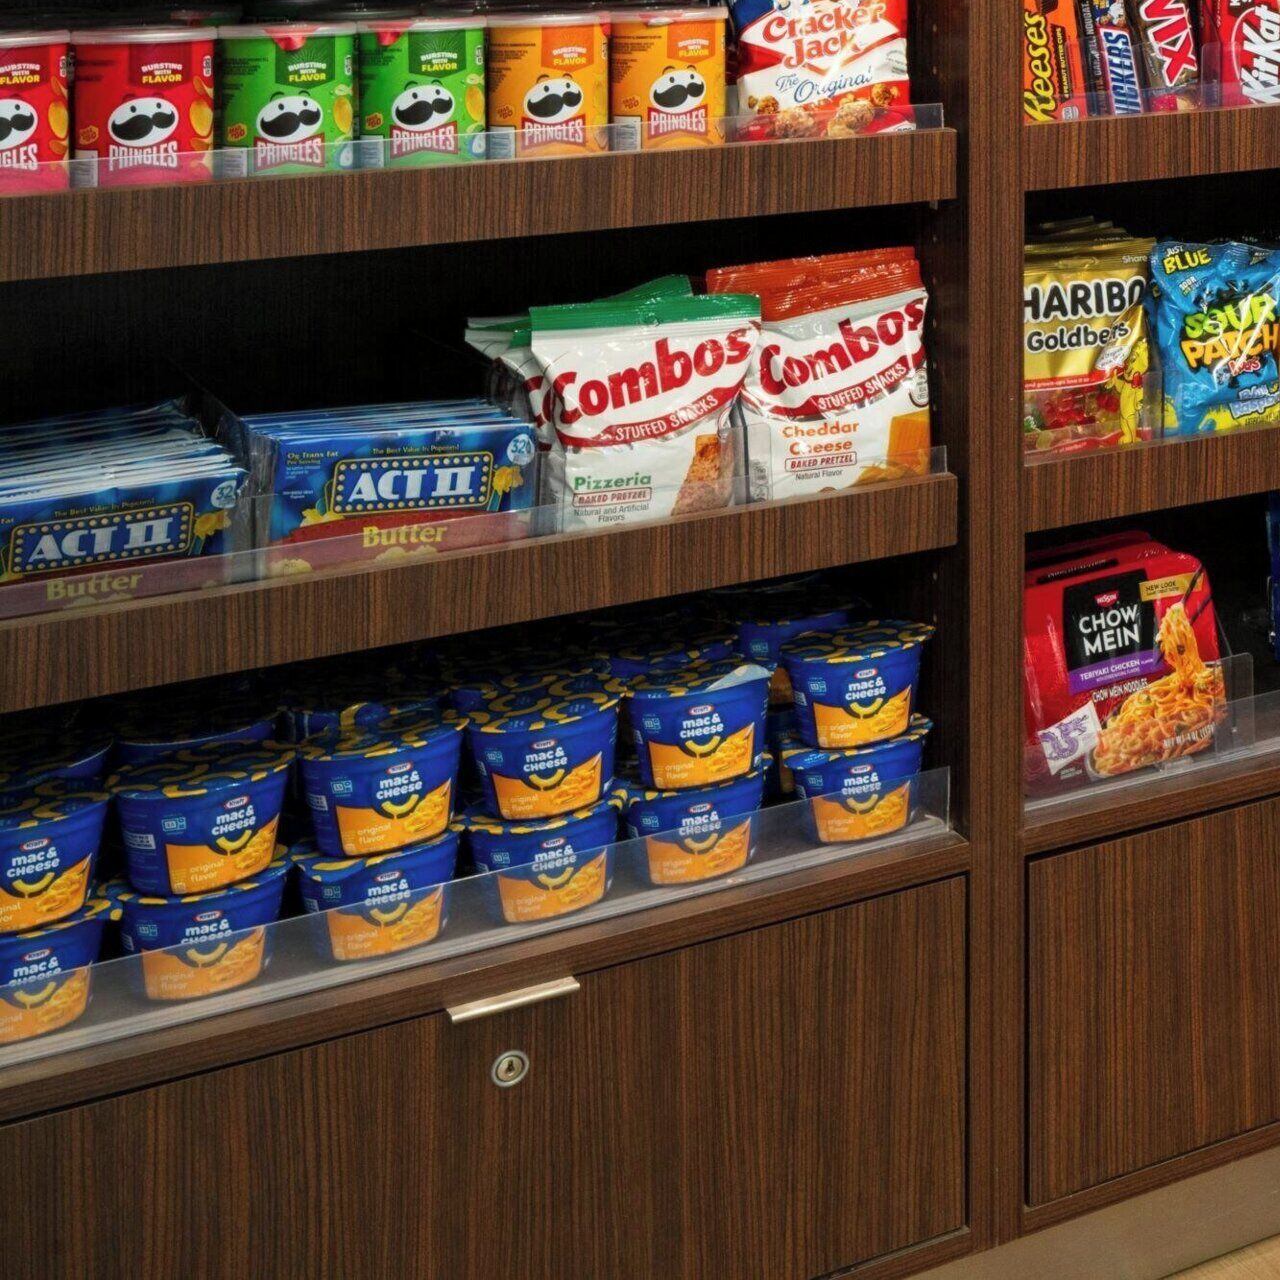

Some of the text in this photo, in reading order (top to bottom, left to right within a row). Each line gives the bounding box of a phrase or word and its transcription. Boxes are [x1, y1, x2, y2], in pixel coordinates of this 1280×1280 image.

[761, 1, 886, 45] Cracker
[782, 32, 862, 71] Jack
[142, 73, 182, 84] FLAVOR
[288, 71, 328, 82] FLAVOR
[775, 74, 800, 92] The
[793, 65, 872, 104] Original
[256, 139, 322, 168] PRINGLES
[391, 126, 455, 154] PRINGLES
[108, 141, 178, 171] PRINGLES
[1163, 248, 1212, 274] BLUE
[1165, 245, 1184, 256] JUST
[1024, 276, 1146, 320] HARIBO
[1185, 293, 1276, 337] SOUR
[758, 297, 925, 396] Combos
[1181, 324, 1279, 368] PATCH
[553, 326, 754, 427] Combos
[817, 363, 907, 411] STUFFED SNACKS
[614, 394, 719, 441] STUFFED SNACKS
[782, 421, 860, 439] Cheddar
[788, 438, 853, 456] Cheese
[789, 453, 854, 469] BAKED PRETZEL
[349, 466, 476, 502] ACT II
[574, 472, 652, 490] Pizzeria
[27, 517, 172, 563] ACT II
[362, 524, 448, 548] Butter
[46, 570, 143, 603] Butter
[1079, 604, 1138, 633] CHOW
[1083, 623, 1140, 656] MEIN
[848, 676, 884, 690] mac &
[1080, 659, 1140, 681] TERIYAKI CHICKEN
[357, 822, 391, 836] original
[357, 833, 385, 845] flavor
